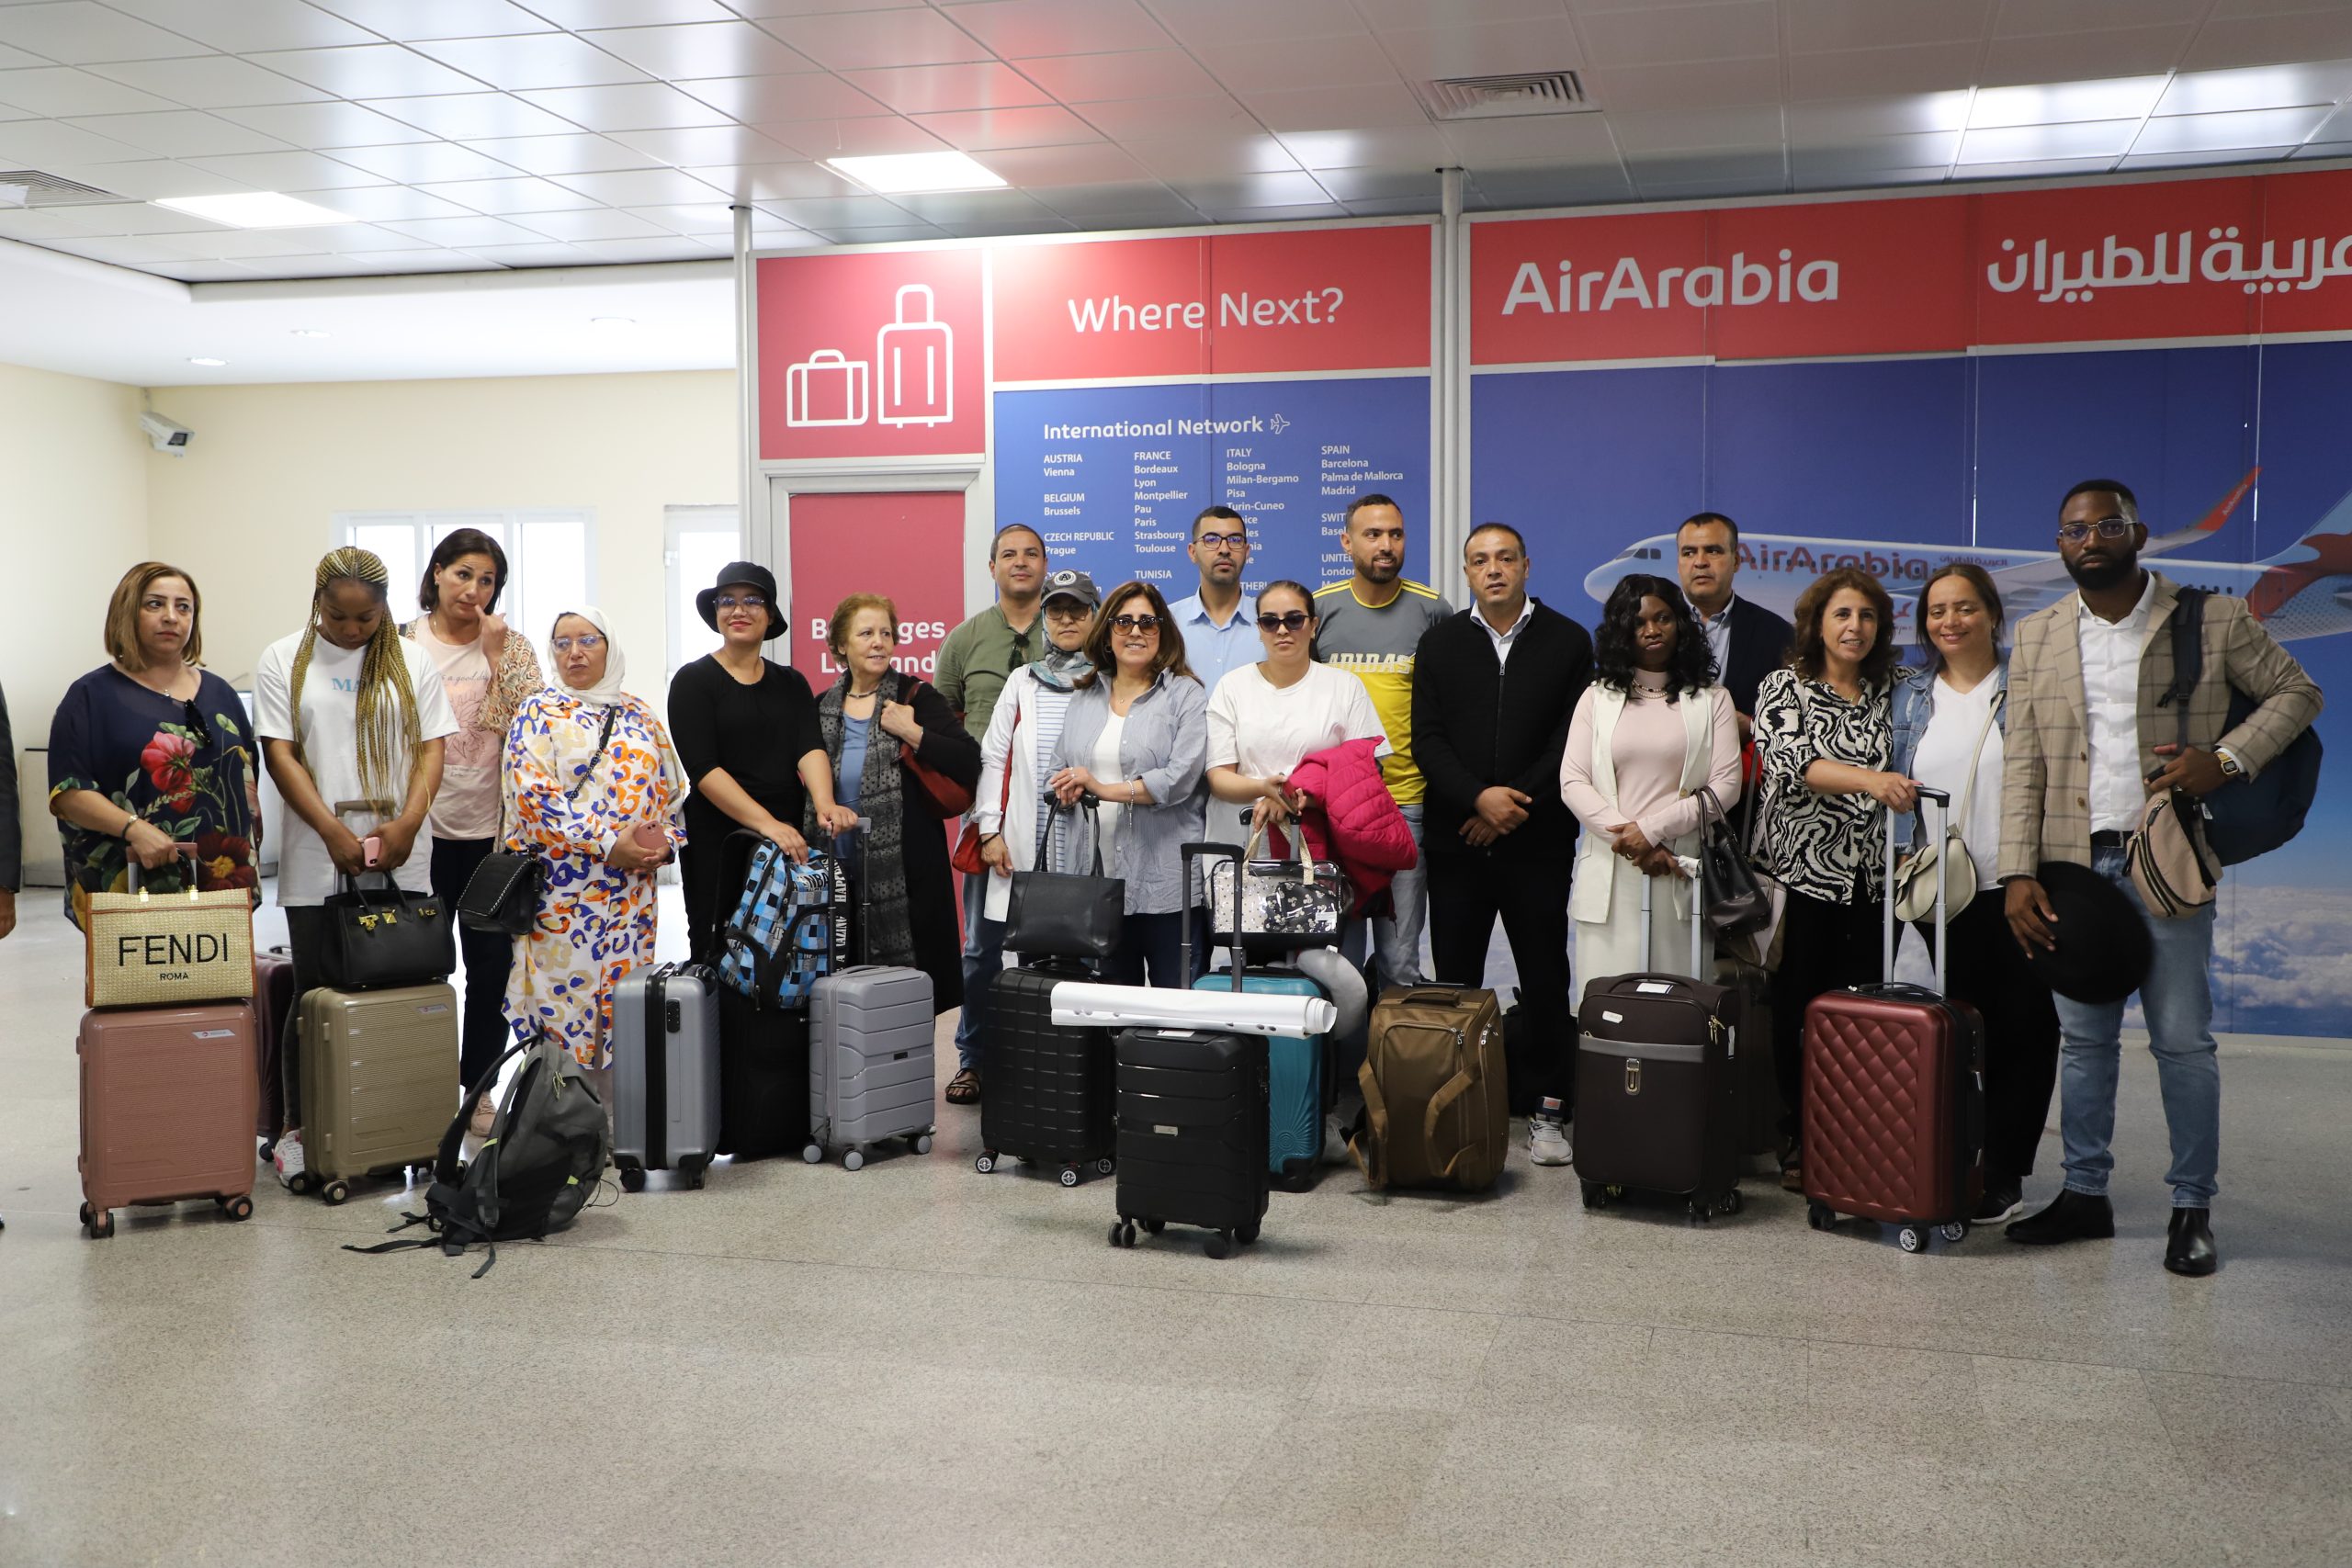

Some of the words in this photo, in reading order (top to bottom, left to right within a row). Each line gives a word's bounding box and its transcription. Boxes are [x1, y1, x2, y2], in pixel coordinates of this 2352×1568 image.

[1987, 231, 2192, 303] للطيران
[1502, 249, 1838, 315] AirArabia
[1068, 295, 1204, 333] Where
[1220, 288, 1344, 327] Next?
[1044, 419, 1172, 439] International
[1178, 416, 1263, 435] Network
[1227, 448, 1252, 457] ITALY
[1321, 446, 1350, 455] SPAIN
[1044, 454, 1082, 463] AUSTRIA
[1134, 451, 1171, 460] FRANCE
[1227, 462, 1266, 472] Bologna
[1321, 458, 1369, 468] Barcelona
[1044, 468, 1075, 477] Vienna
[1134, 465, 1179, 474] Bordeaux
[1227, 475, 1299, 486] Milan-Bergamo
[1321, 472, 1349, 481] Palma
[1351, 472, 1363, 480] de
[1364, 471, 1404, 480] Mallorca
[1134, 479, 1157, 489] Lyon
[1227, 489, 1246, 498] Pisa
[1321, 486, 1356, 496] Madrid
[1044, 493, 1085, 502] BELGIUM
[1134, 491, 1189, 502] Montpellier
[1044, 506, 1081, 515] Brussels
[1134, 505, 1152, 514] Pau
[1227, 502, 1285, 512] Turin-Cuneo
[1134, 518, 1157, 527] Paris
[1242, 515, 1258, 524] ice
[1044, 533, 1072, 541] CZECH
[1074, 532, 1114, 541] REPUBLIC
[1134, 531, 1185, 542] Strasbourg
[1045, 547, 1077, 557] Prague
[1134, 544, 1176, 553] Toulouse
[1134, 570, 1172, 579] TUNISIA
[1328, 653, 1410, 674] ADIDAS
[119, 933, 228, 966] FENDI
[159, 973, 189, 981] ROMA
